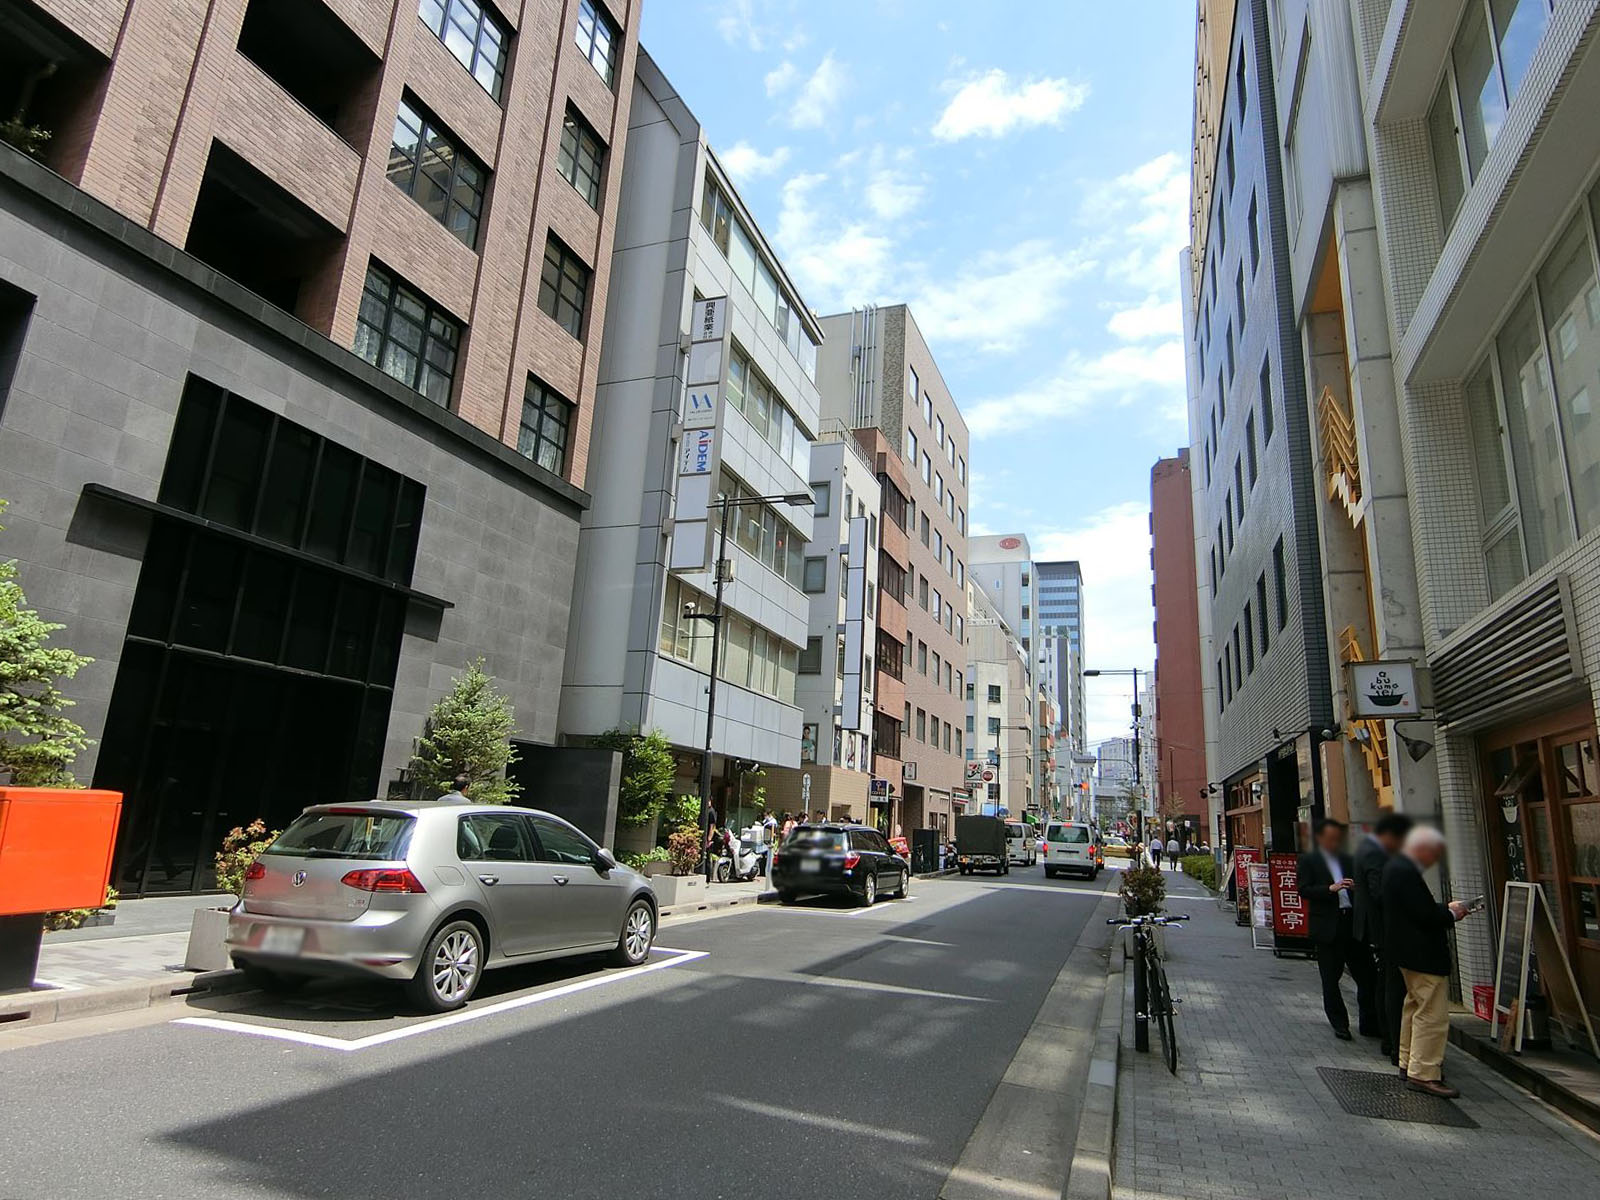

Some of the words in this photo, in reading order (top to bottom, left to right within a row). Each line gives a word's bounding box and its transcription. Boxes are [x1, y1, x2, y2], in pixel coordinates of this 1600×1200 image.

[1376, 676, 1391, 684] bu
[1370, 682, 1399, 690] kuma
[1276, 870, 1305, 931] 南国亭
